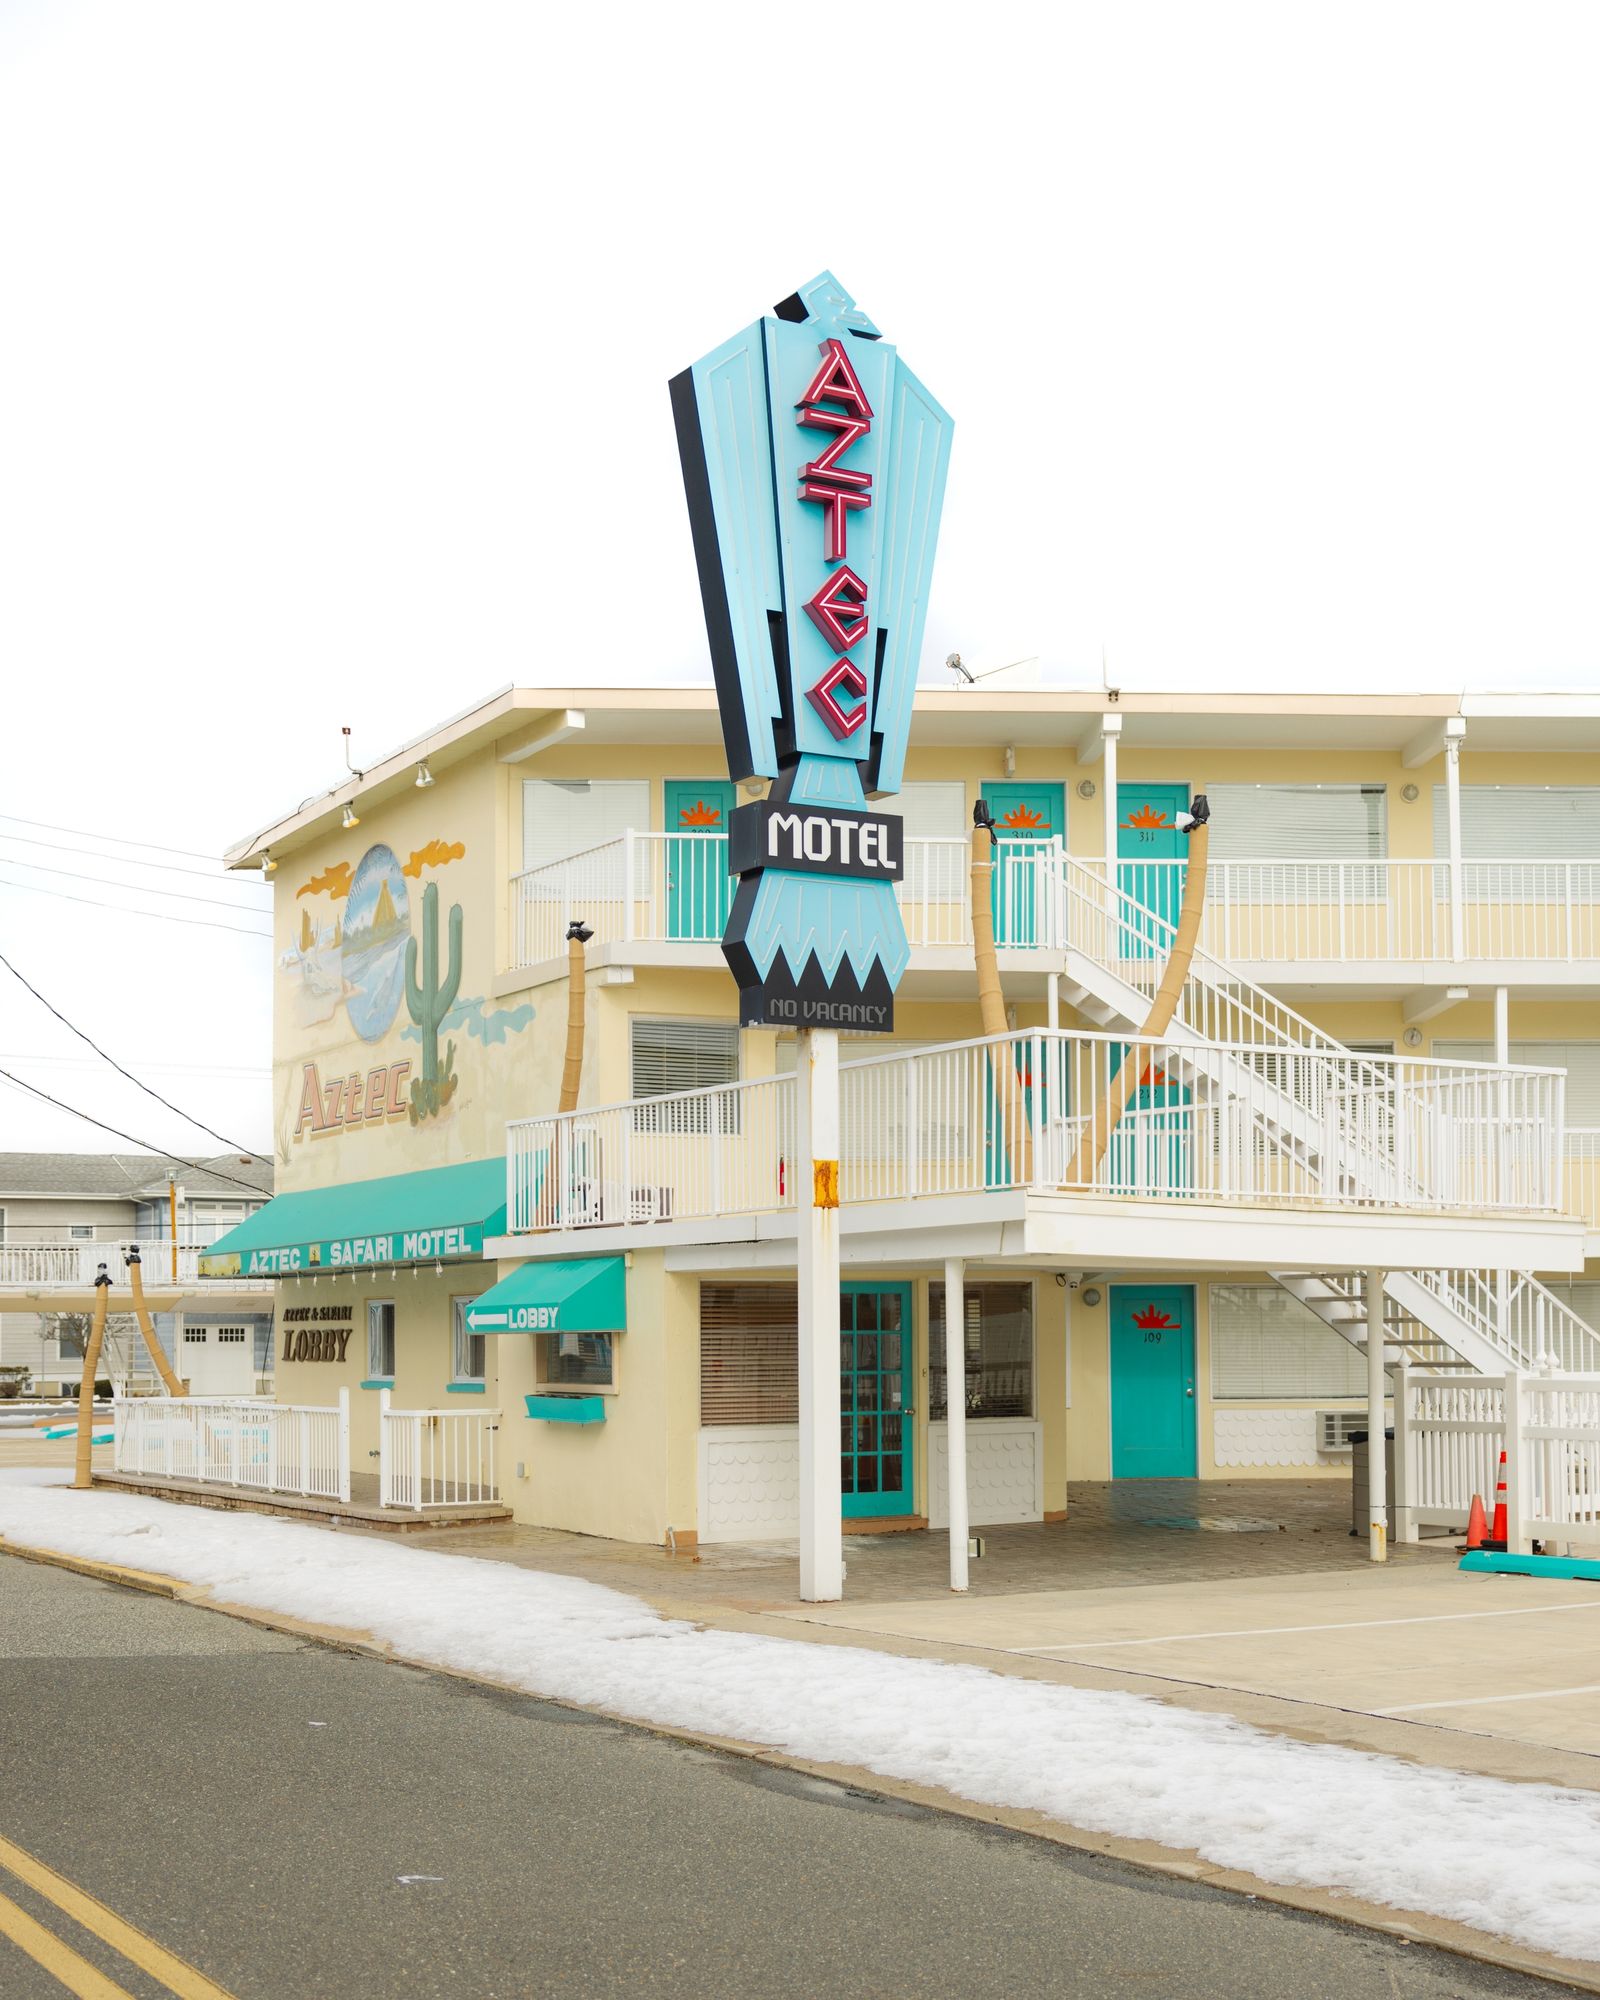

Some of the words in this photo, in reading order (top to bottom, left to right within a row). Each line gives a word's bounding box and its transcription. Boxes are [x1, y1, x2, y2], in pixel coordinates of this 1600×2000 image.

[795, 337, 875, 742] AZTEC
[768, 811, 897, 870] MOTEL
[1139, 831, 1155, 842] 311
[770, 998, 797, 1018] NO
[803, 1000, 887, 1024] VACANCY
[294, 1060, 411, 1141] Aztec
[249, 1248, 301, 1273] AZTEC
[330, 1236, 393, 1266] SAFARI
[403, 1227, 472, 1258] MOTEL
[283, 1307, 311, 1321] AZTEC
[319, 1305, 353, 1321] SAFARI
[508, 1307, 559, 1329] LOBBY
[282, 1328, 353, 1363] LOBBY
[1144, 1332, 1161, 1344] 109
